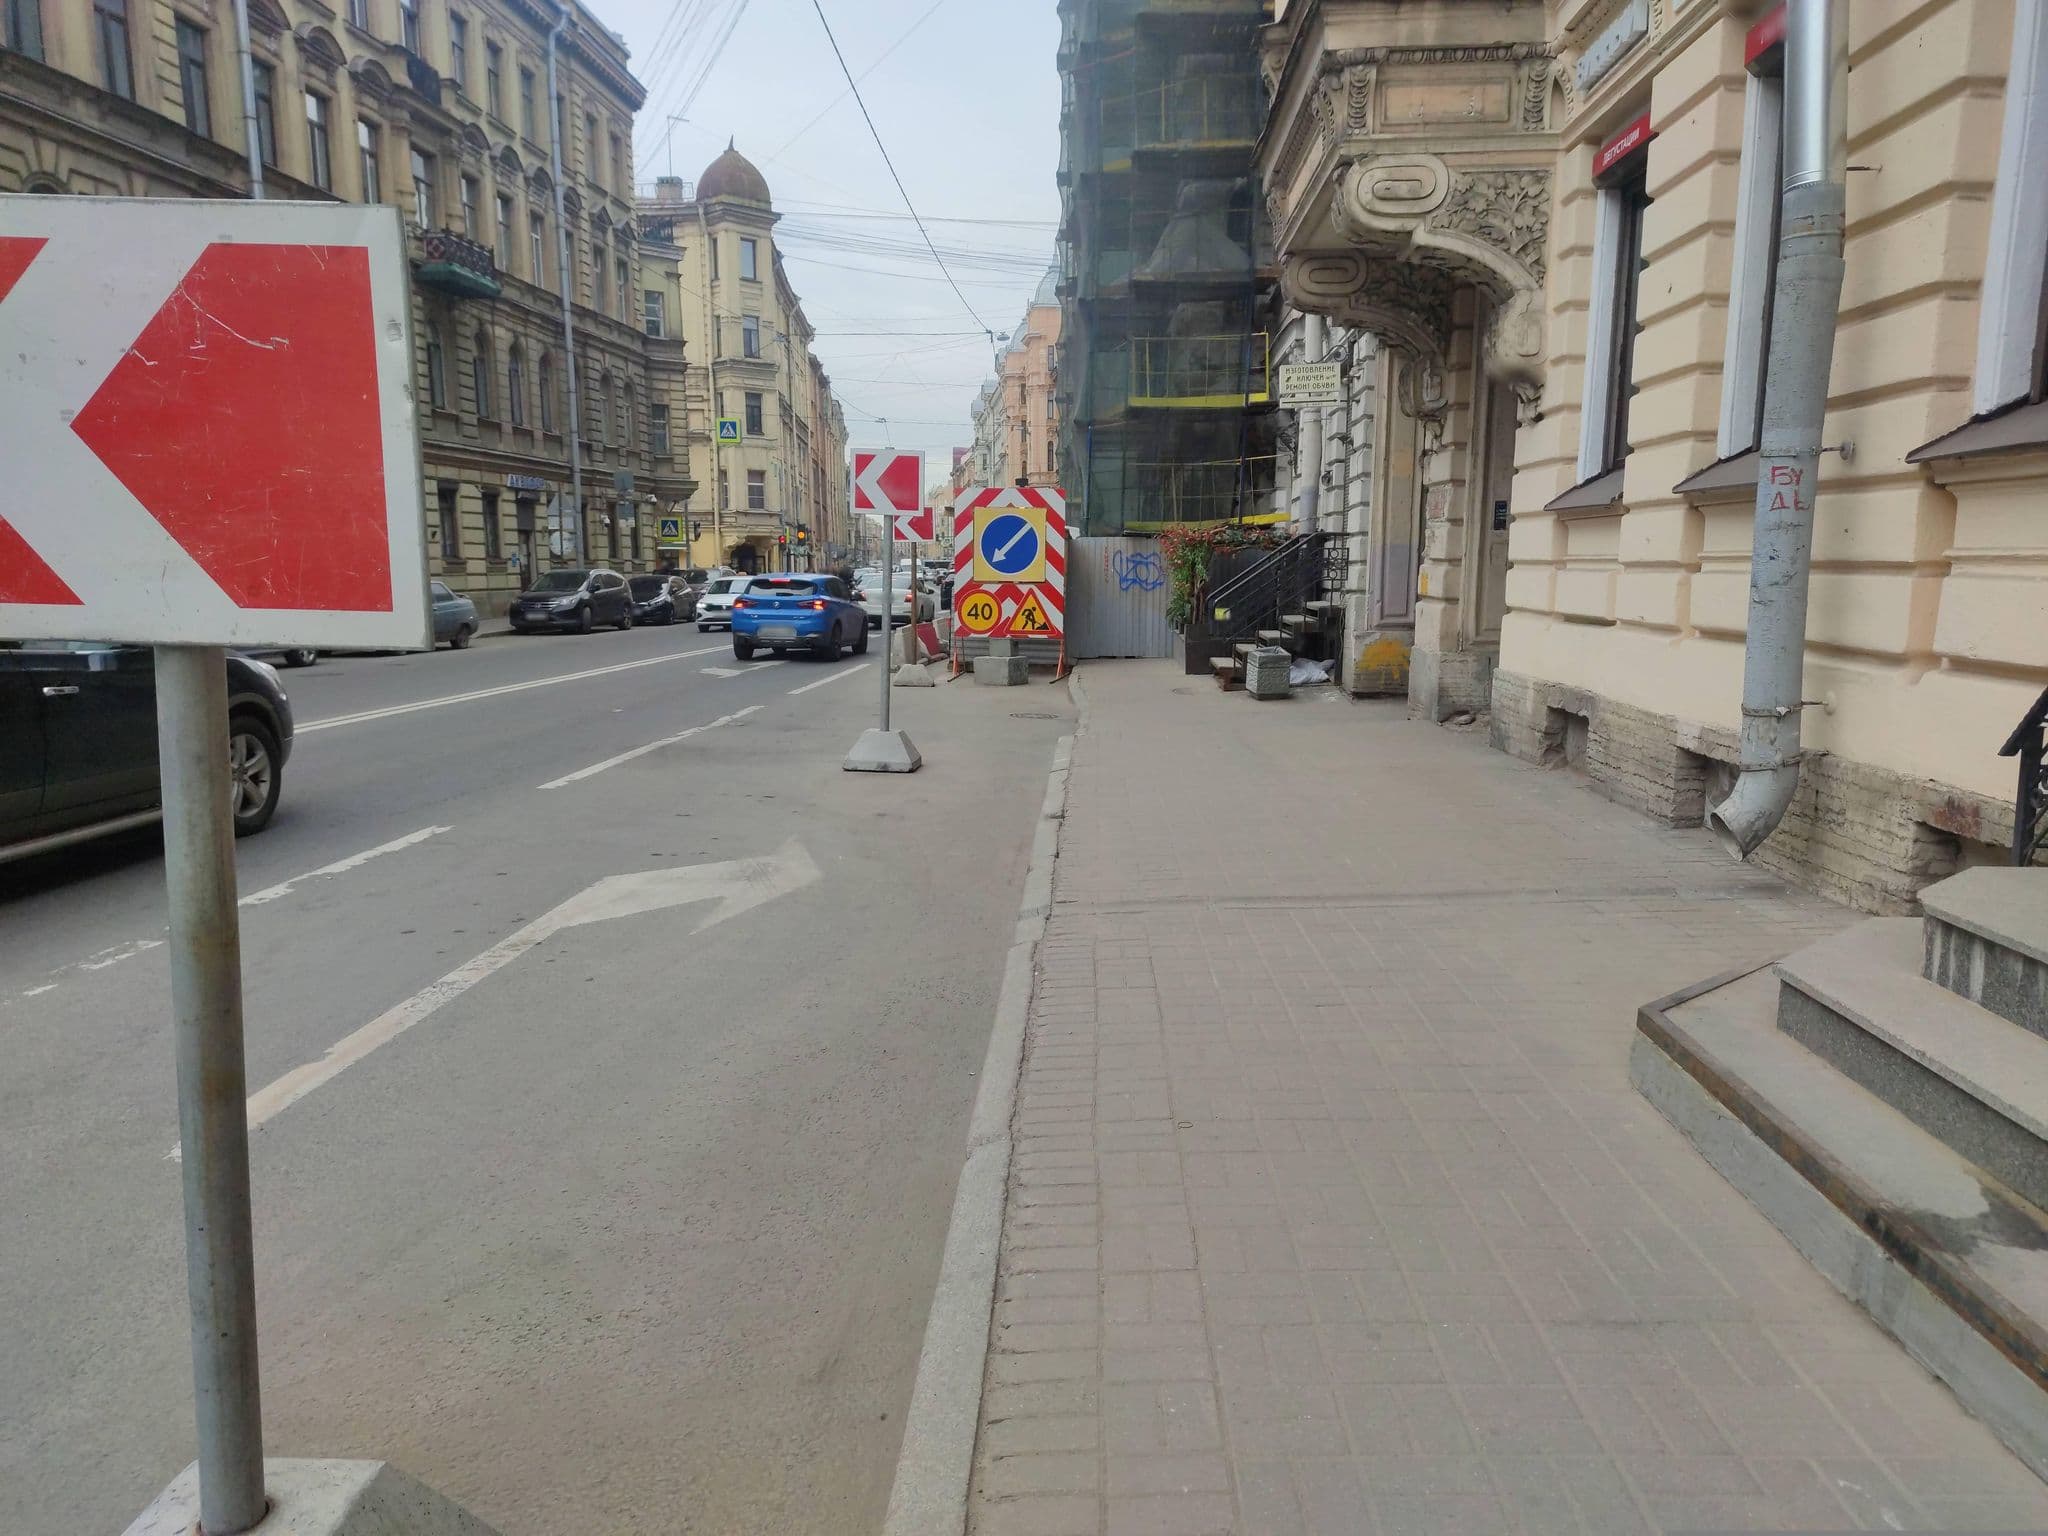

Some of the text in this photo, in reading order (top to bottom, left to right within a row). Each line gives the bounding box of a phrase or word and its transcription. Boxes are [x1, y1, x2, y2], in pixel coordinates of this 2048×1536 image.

[1602, 127, 1640, 166] ДЕГУСТАЦИИ
[1285, 365, 1335, 374] ИЗГОТОВЛЕНИЕ
[1312, 382, 1335, 390] ОБУВИ
[967, 602, 993, 621] 40
